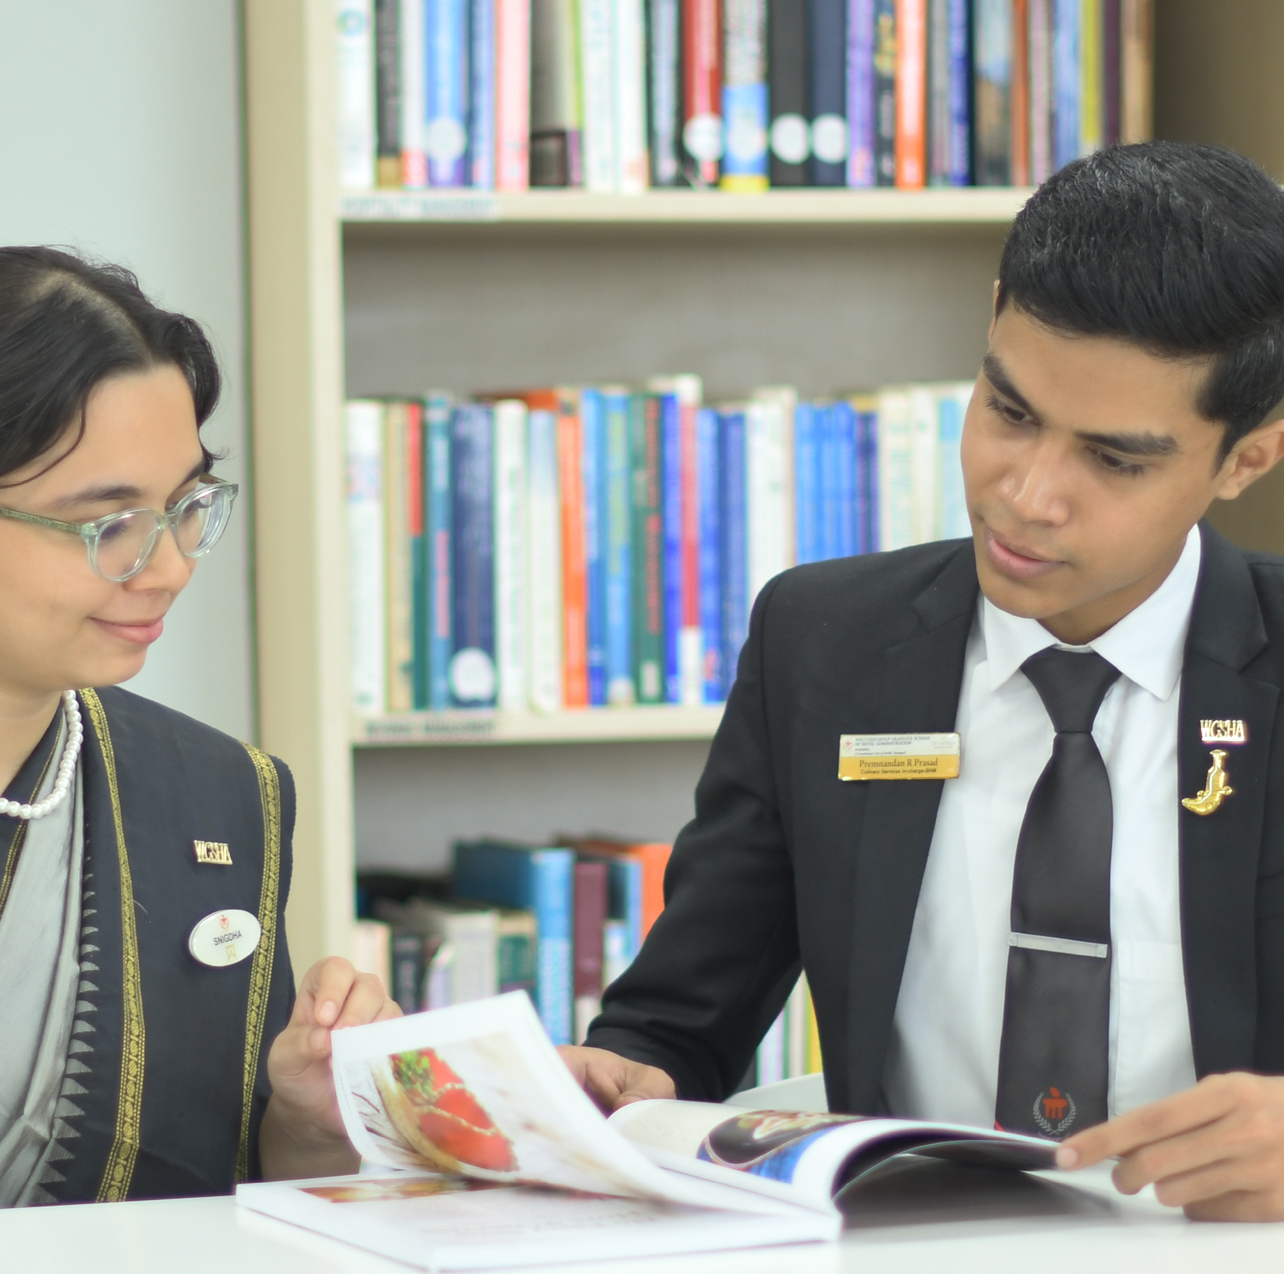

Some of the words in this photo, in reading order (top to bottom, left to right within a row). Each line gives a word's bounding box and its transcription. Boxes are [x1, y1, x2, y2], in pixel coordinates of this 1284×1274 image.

[1200, 719, 1245, 741] WGSHA
[859, 759, 905, 768] Premnandan
[907, 758, 913, 767] R
[914, 758, 938, 767] Prasad
[213, 930, 243, 946] SNIGDHA
